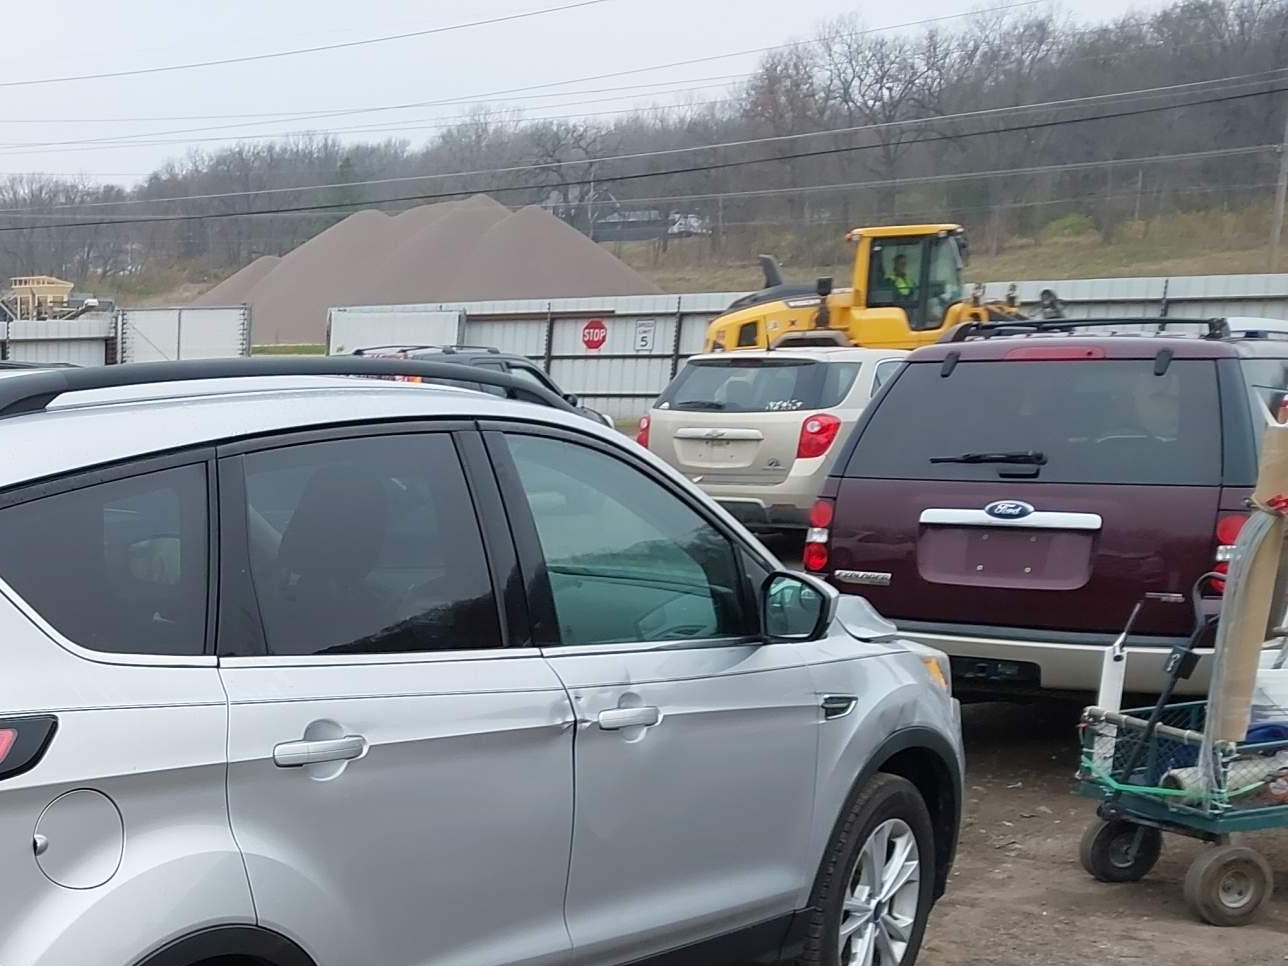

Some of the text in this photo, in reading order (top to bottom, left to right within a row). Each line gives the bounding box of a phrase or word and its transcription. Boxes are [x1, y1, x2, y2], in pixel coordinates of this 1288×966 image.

[583, 328, 606, 341] STOP
[639, 336, 649, 348] 5
[994, 502, 1023, 515] Ford
